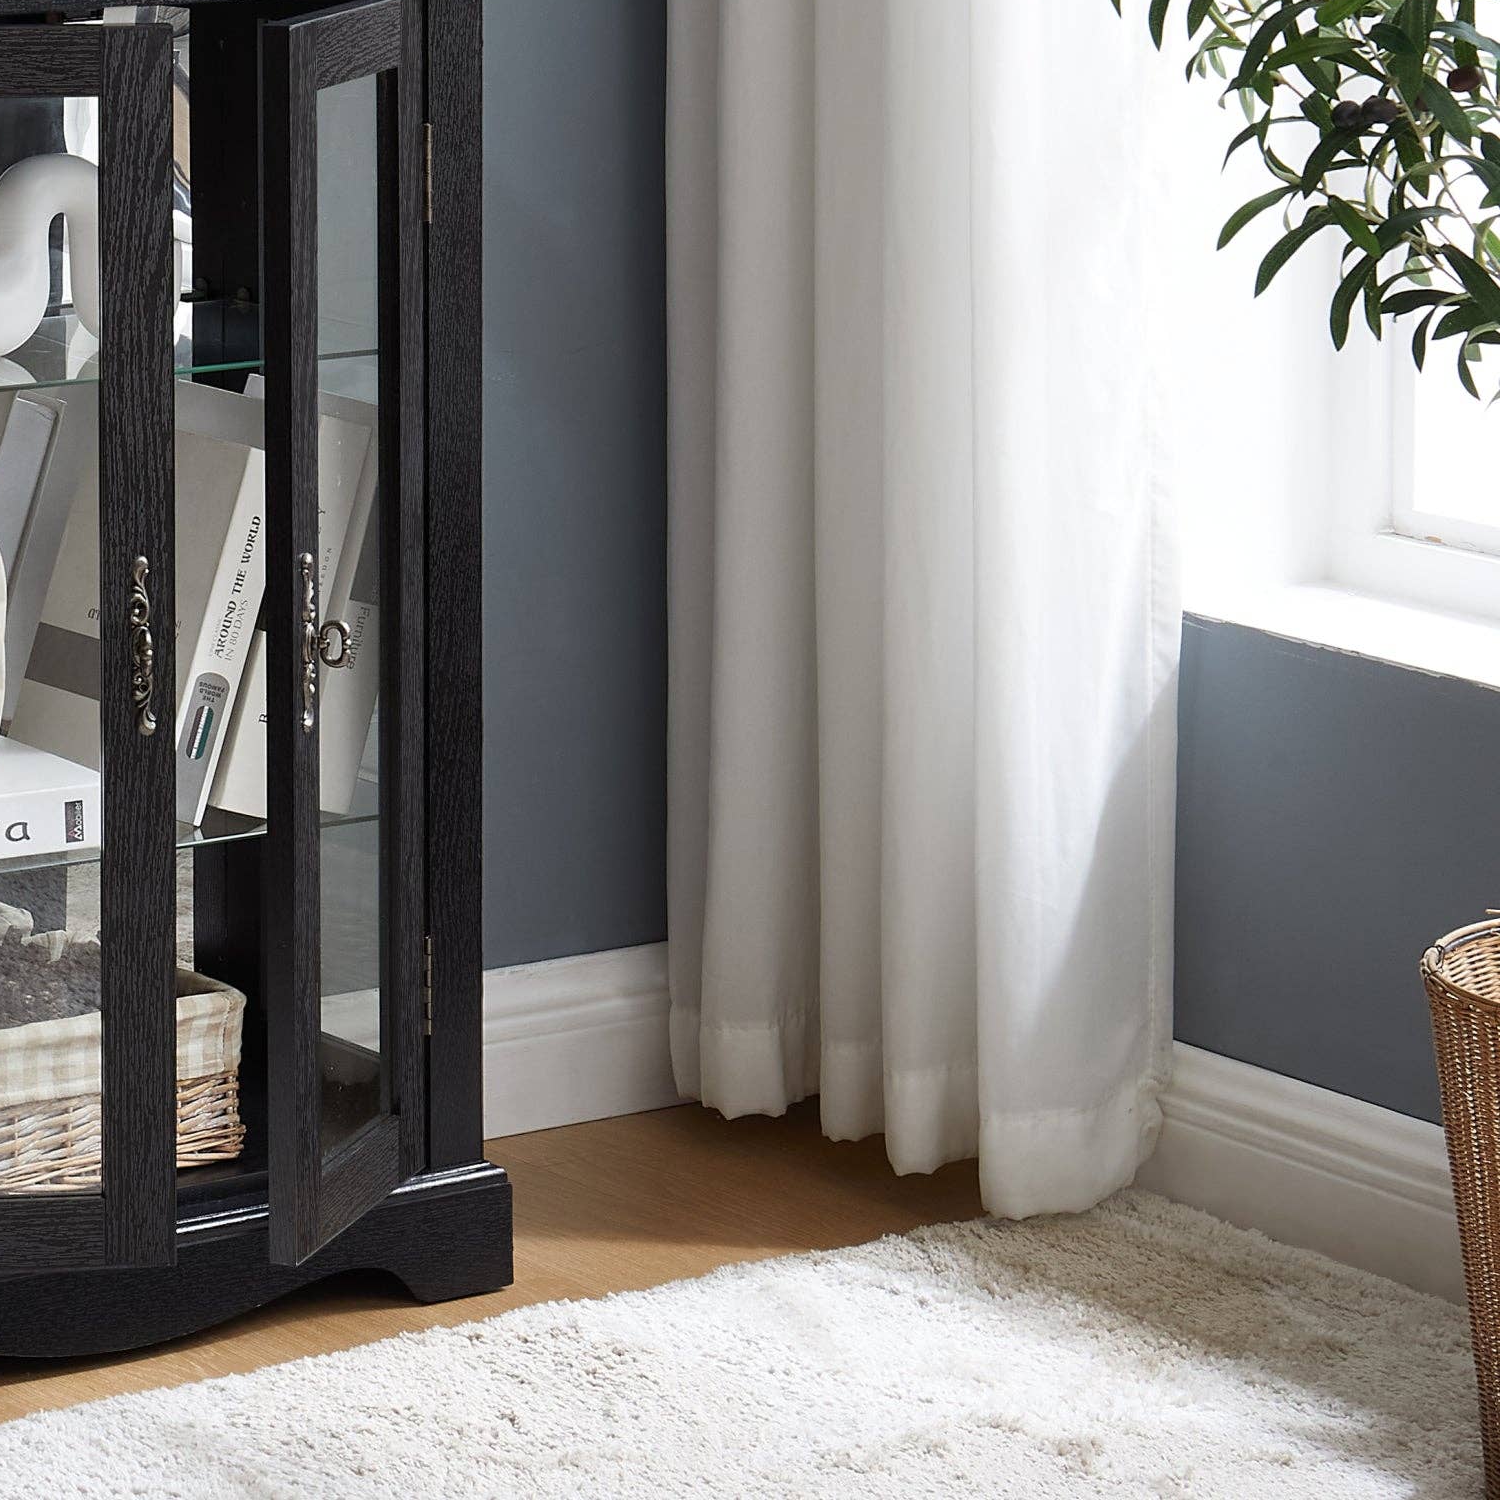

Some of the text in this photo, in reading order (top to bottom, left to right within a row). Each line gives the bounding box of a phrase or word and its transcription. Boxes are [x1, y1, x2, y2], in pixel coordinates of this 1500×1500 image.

[214, 600, 238, 659] AROUND
[231, 569, 248, 596] THE
[240, 515, 262, 565] WORLD
[224, 600, 249, 661] IN 80 DAYS
